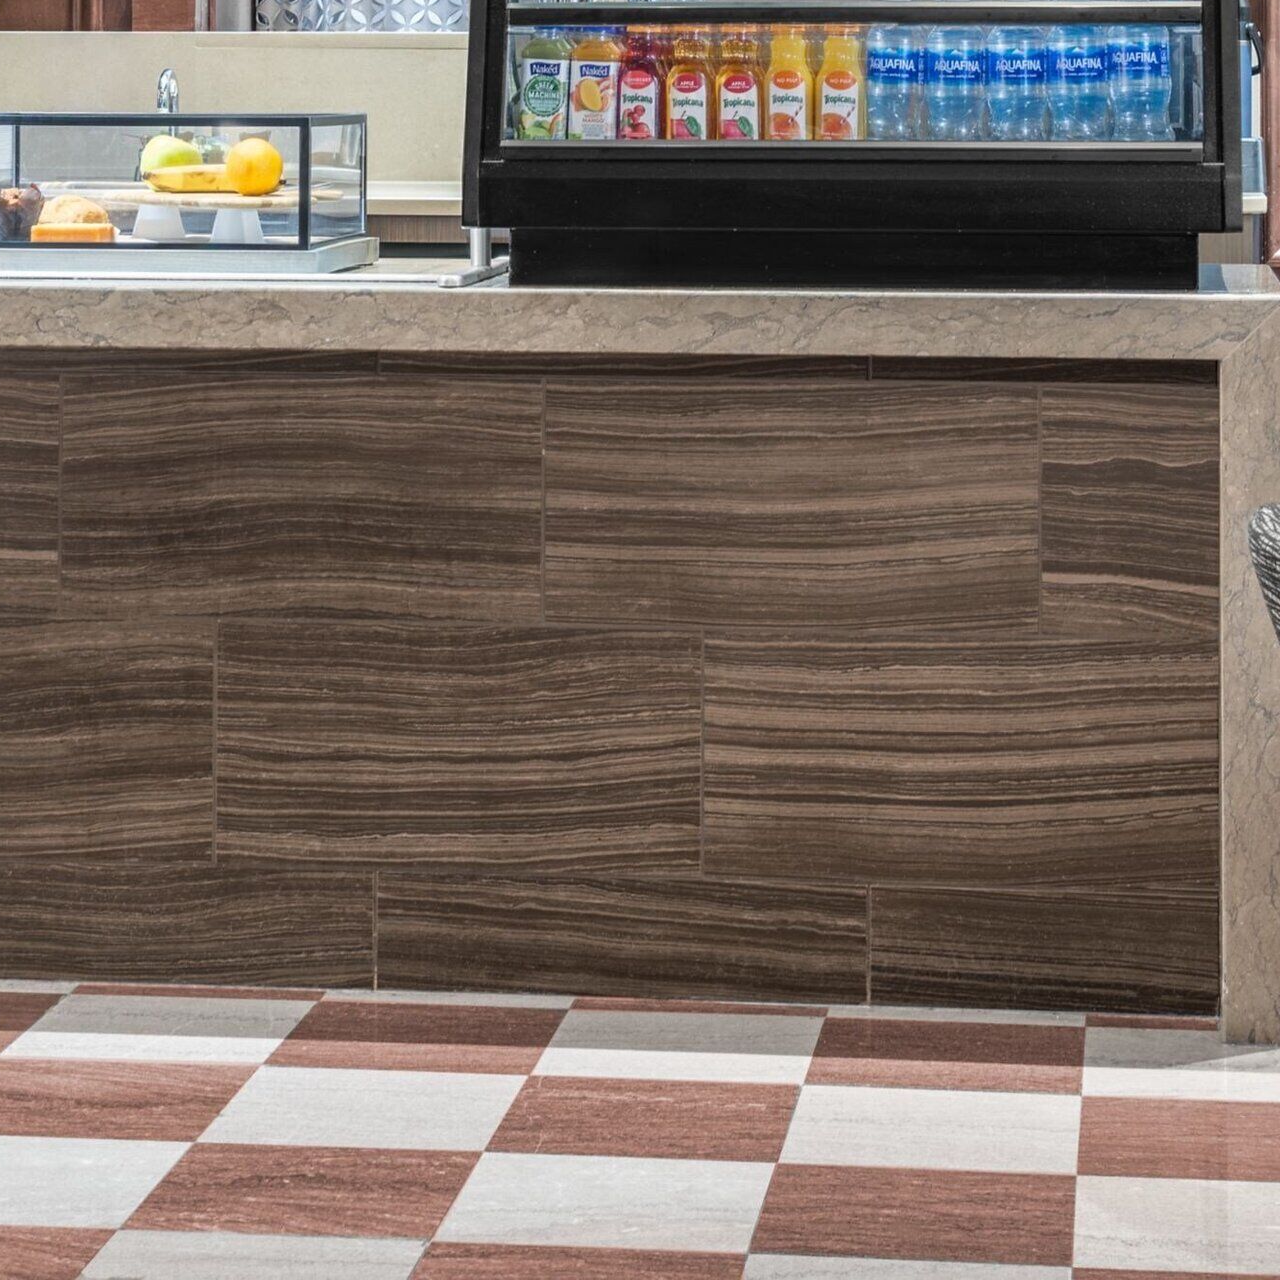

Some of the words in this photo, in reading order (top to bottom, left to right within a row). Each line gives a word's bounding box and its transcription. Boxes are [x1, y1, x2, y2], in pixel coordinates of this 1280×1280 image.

[1112, 52, 1159, 64] AQUAFINA
[870, 58, 916, 71] AQUAFINA
[934, 60, 982, 73] AQUAFINA
[996, 59, 1042, 72] AQUAFINA
[1056, 57, 1103, 71] AQUAFINA
[622, 93, 653, 104] Tropicana
[673, 97, 704, 107] Tropicana
[723, 97, 755, 108] Tropicana
[772, 93, 803, 104] Tropicana
[824, 94, 856, 105] Tropicana
